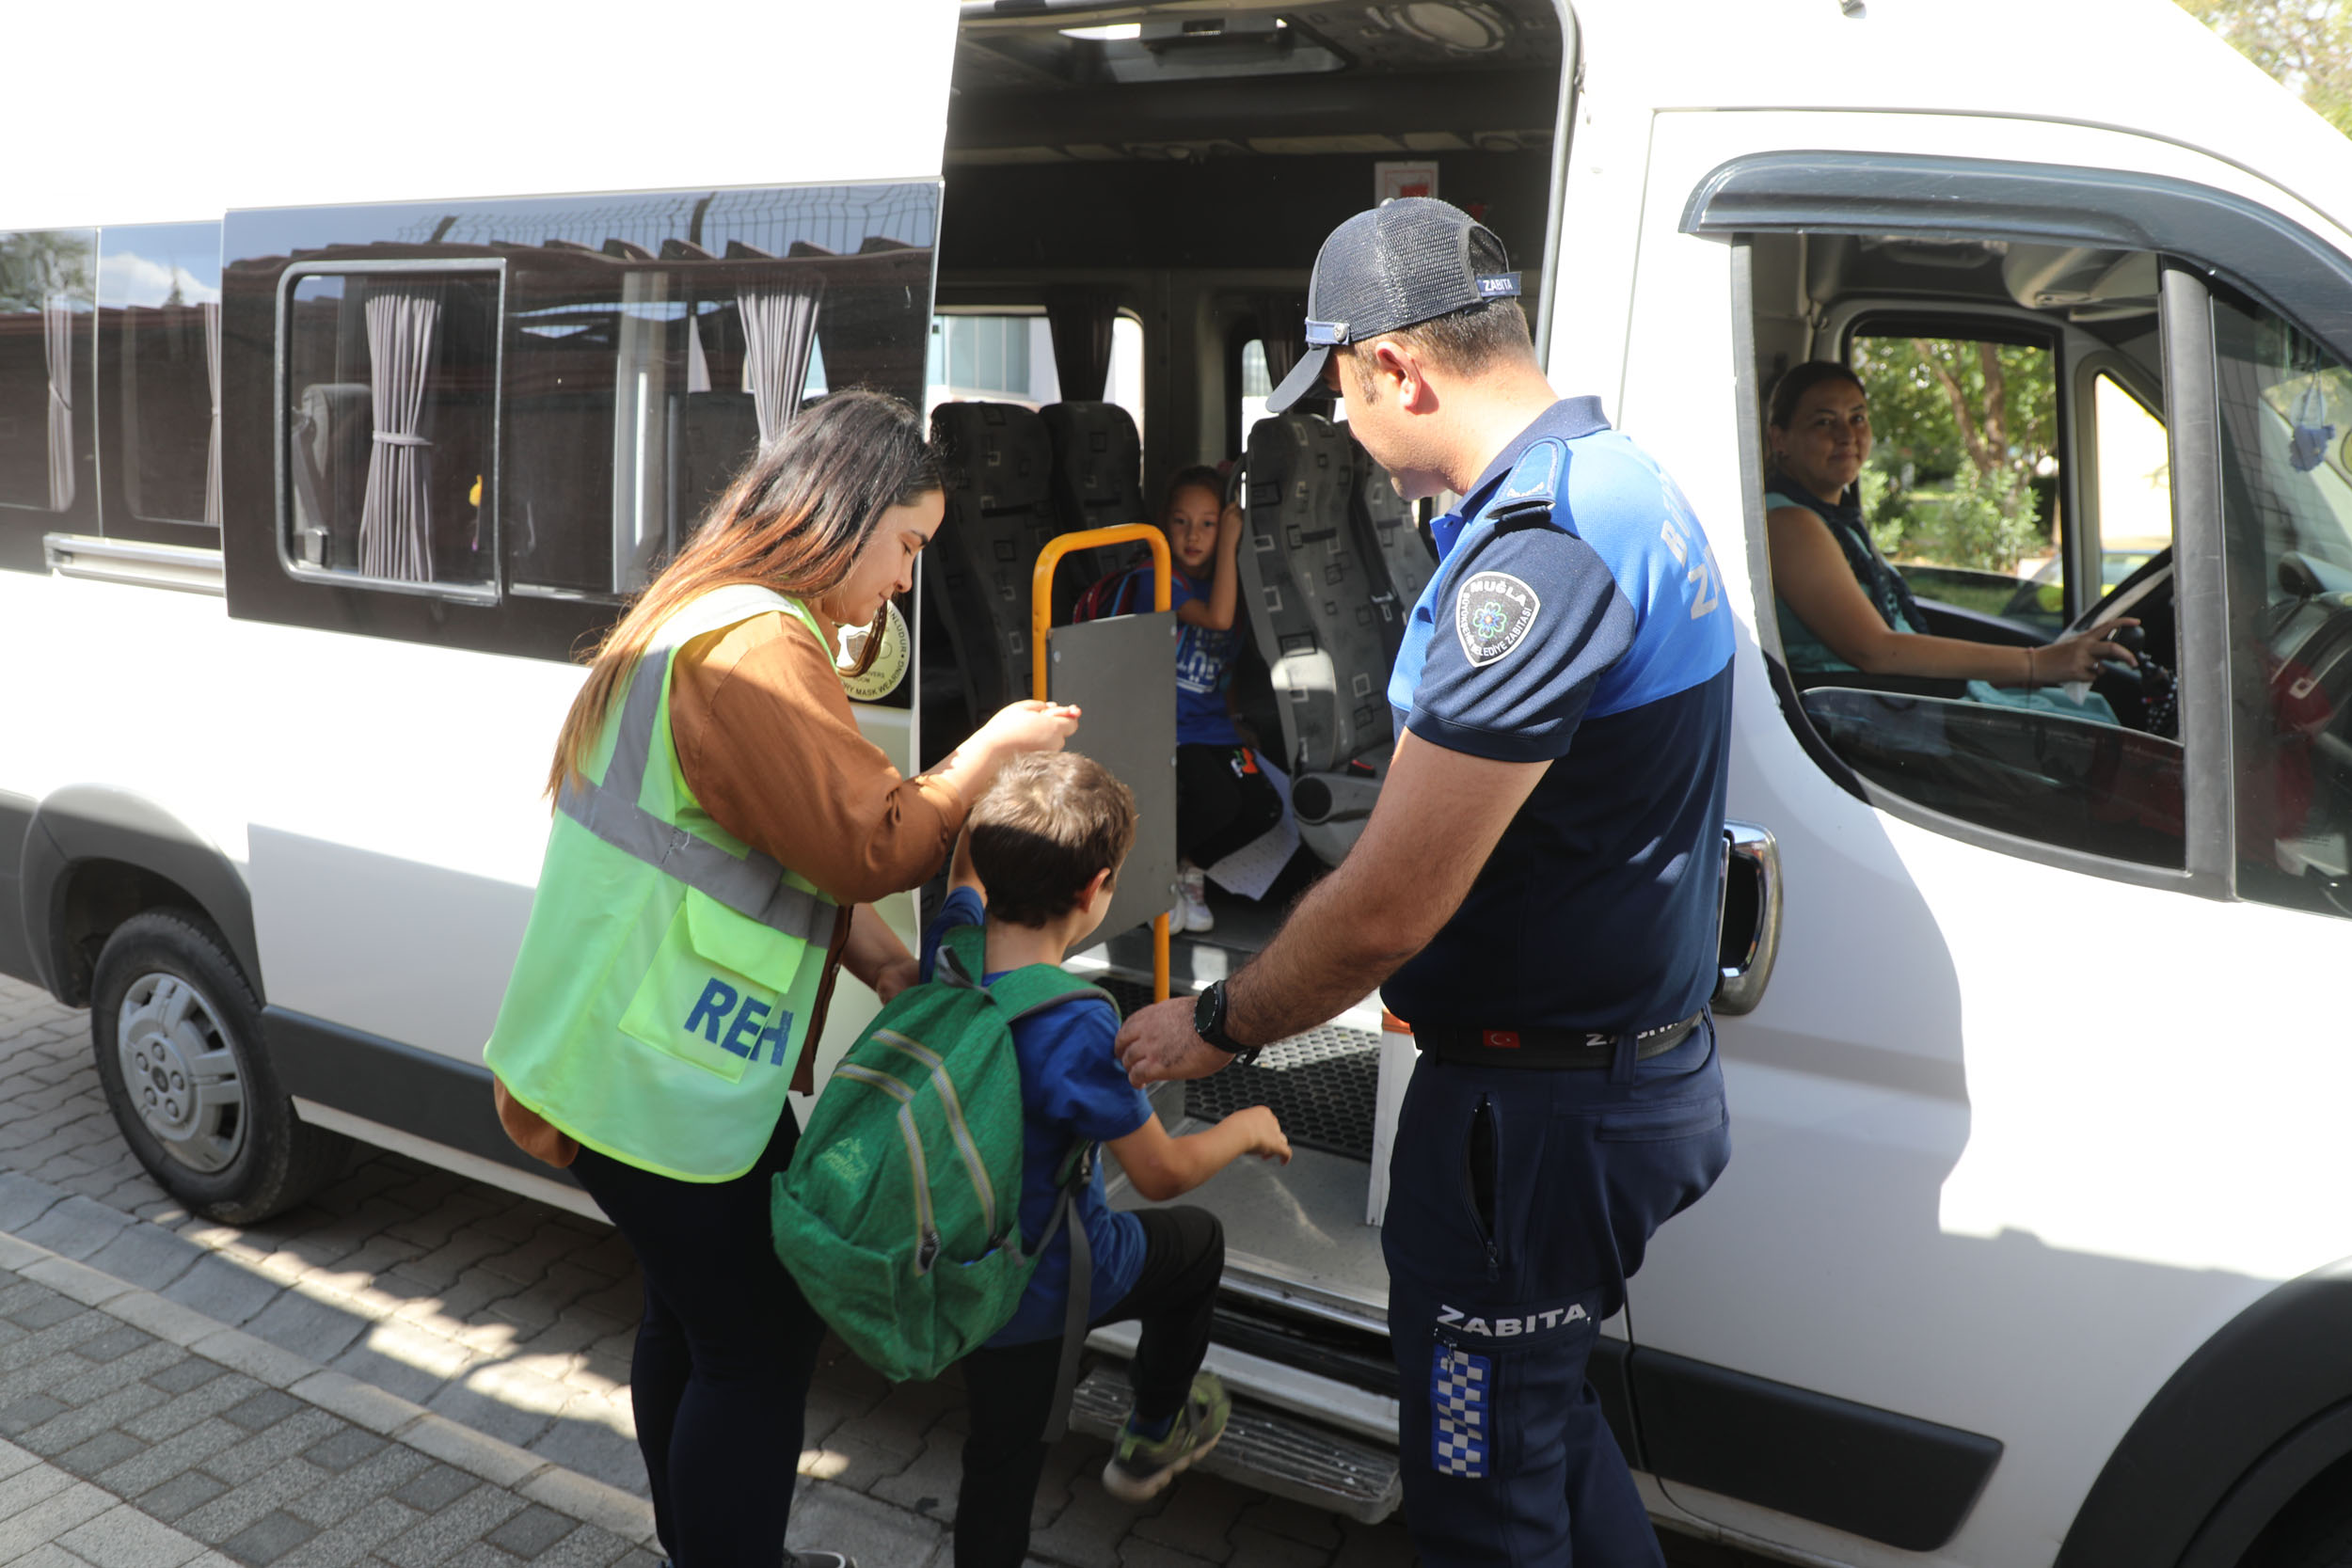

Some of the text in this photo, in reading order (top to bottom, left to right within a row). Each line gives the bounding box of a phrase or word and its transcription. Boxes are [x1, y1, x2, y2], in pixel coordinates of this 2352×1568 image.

[1483, 278, 1513, 292] ZABITA
[1470, 580, 1526, 607] MUĞLA
[1470, 641, 1507, 656] BELEDİYE
[1505, 607, 1533, 645] ZABITASI
[855, 688, 877, 696] MASK
[879, 660, 904, 693] WEARING
[683, 976, 794, 1067] REH
[1437, 1304, 1587, 1337] ZABITA
